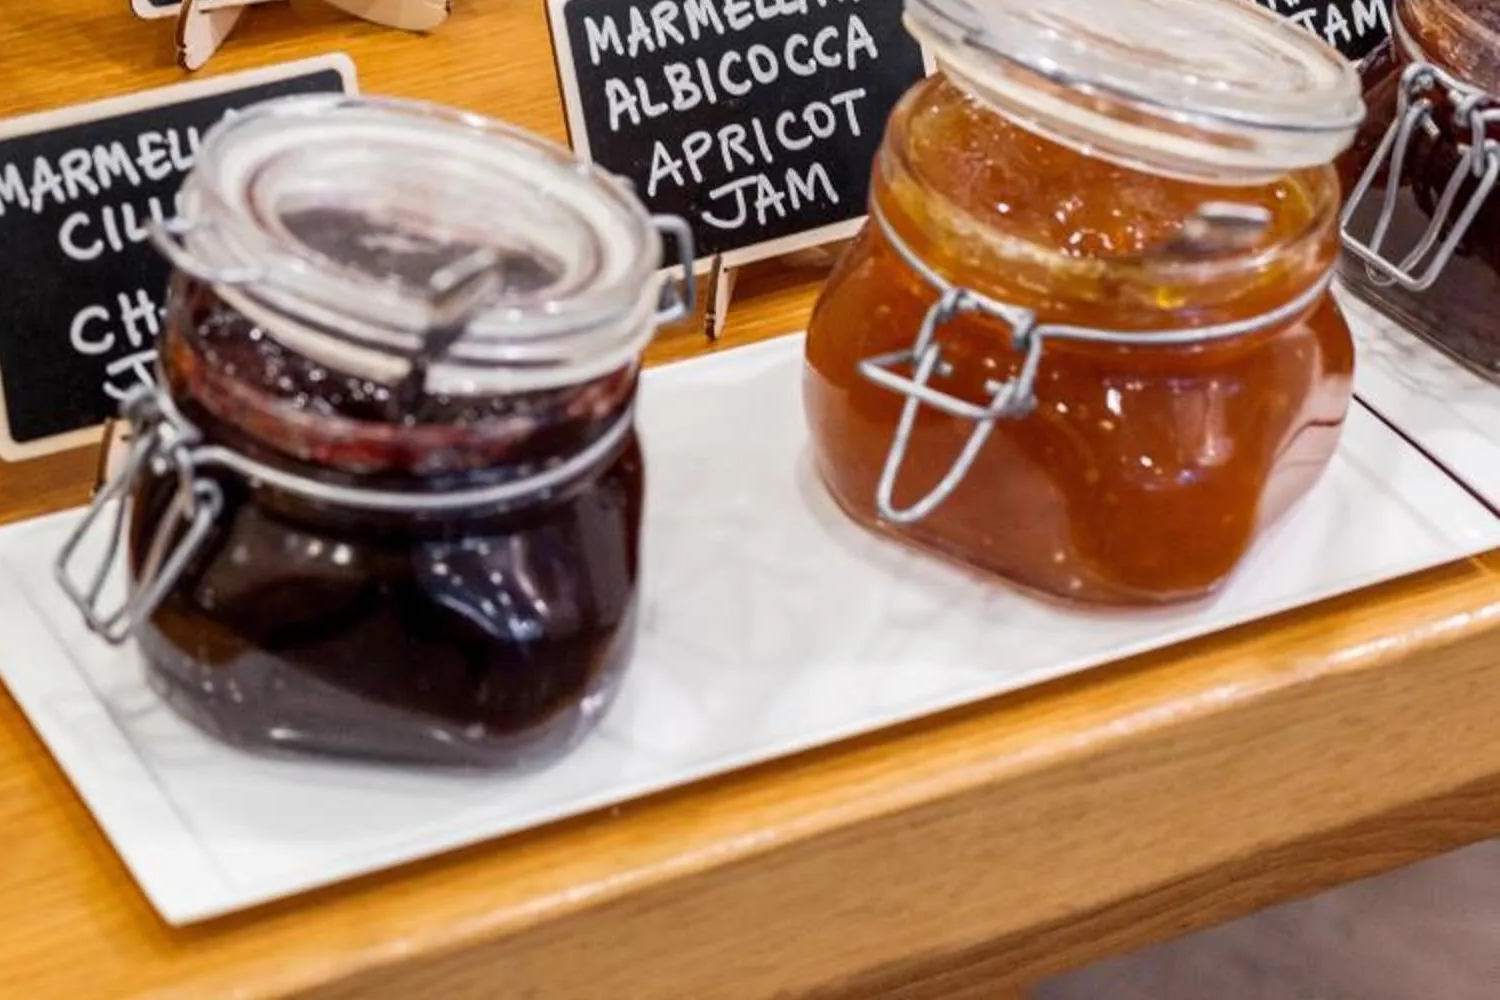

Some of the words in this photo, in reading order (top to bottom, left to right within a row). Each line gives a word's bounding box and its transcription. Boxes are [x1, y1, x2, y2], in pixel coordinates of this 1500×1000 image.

[604, 13, 879, 132] ALBICOCCA
[647, 87, 867, 198] APRICOT
[701, 161, 839, 230] JAM
